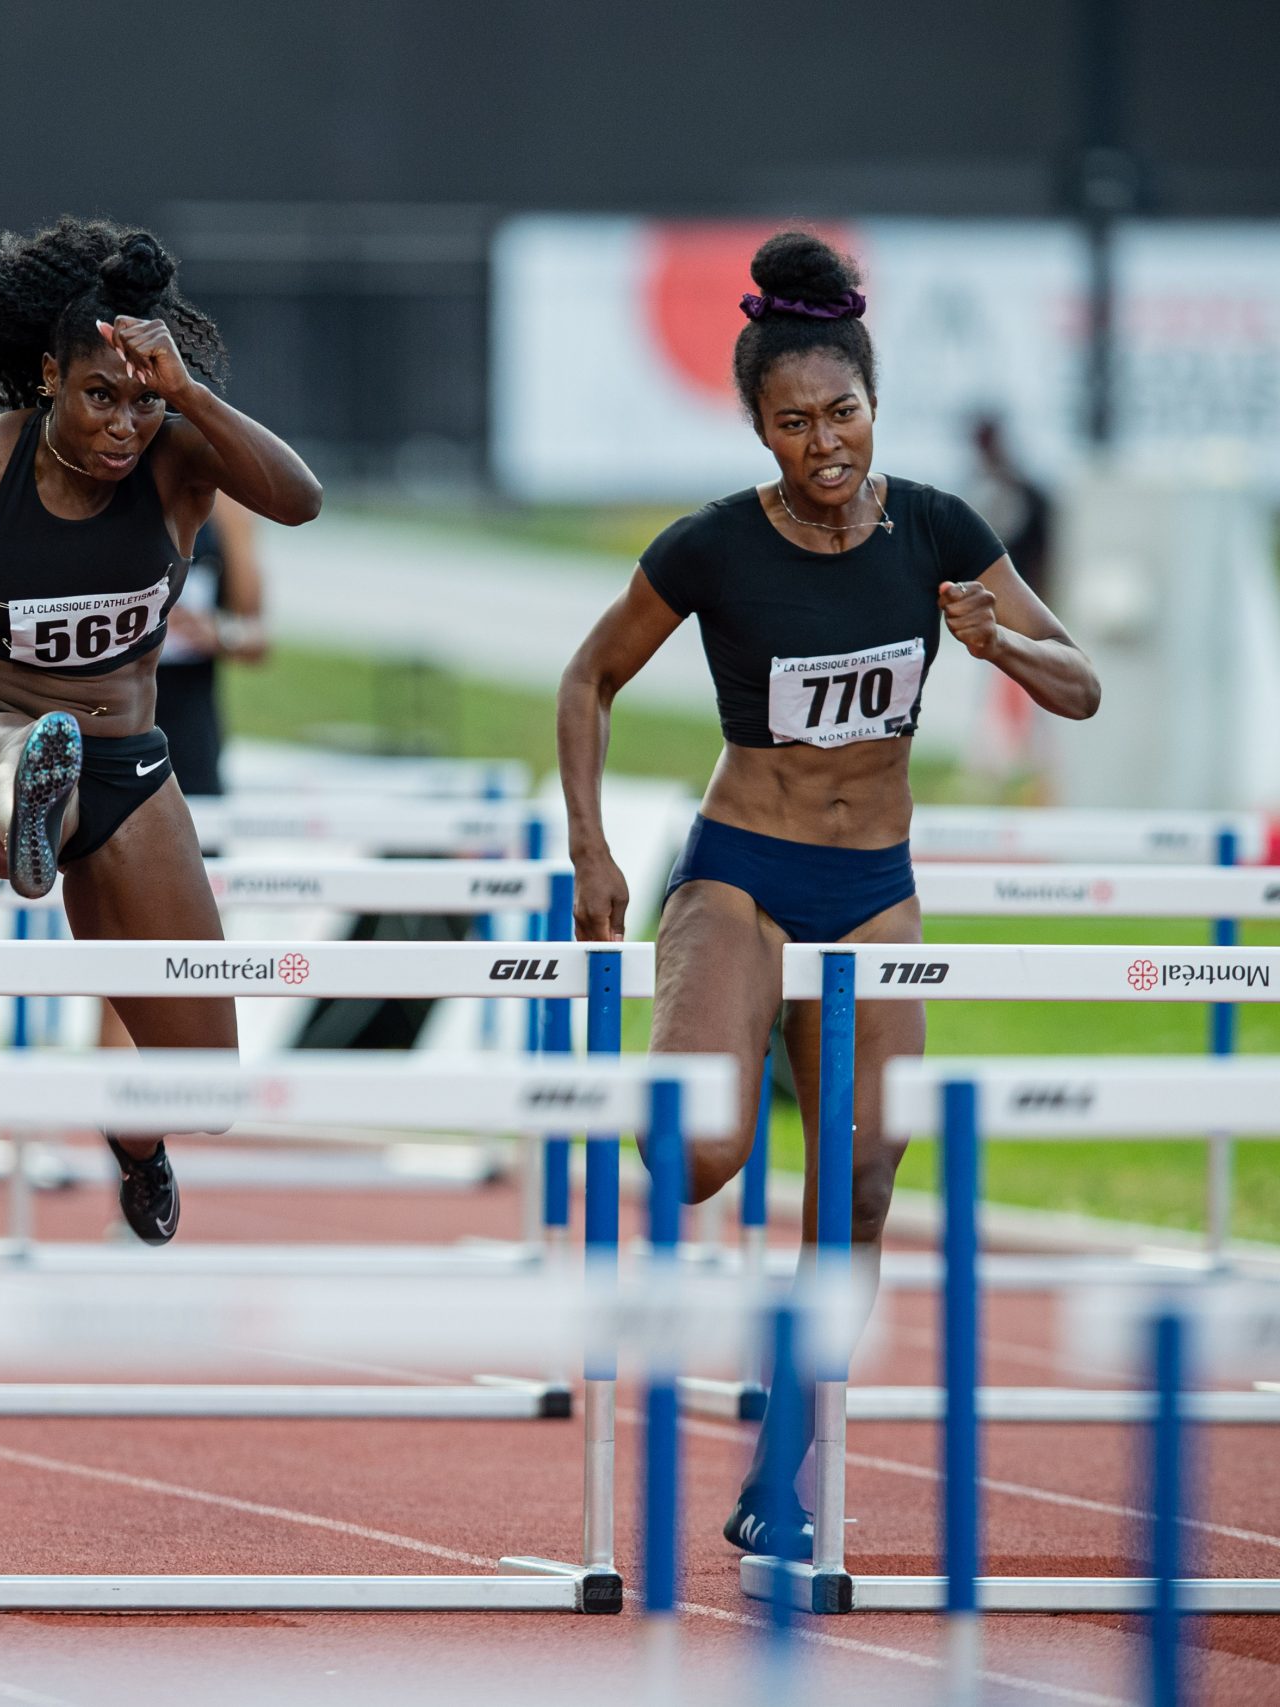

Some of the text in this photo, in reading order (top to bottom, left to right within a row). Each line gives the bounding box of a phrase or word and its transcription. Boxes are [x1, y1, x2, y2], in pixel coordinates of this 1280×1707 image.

[23, 587, 160, 615] LA CLASSIQUE D'ATHLÉTISME
[34, 604, 149, 663] 569
[783, 647, 913, 673] LA CLASSIQUE D'ATHLÉTISME
[802, 667, 893, 729] 770
[819, 726, 877, 743] MONTRÉAL
[166, 957, 274, 981] Montréal
[489, 959, 559, 981] GILL
[880, 962, 950, 984] GILL
[1162, 962, 1270, 987] Montréal
